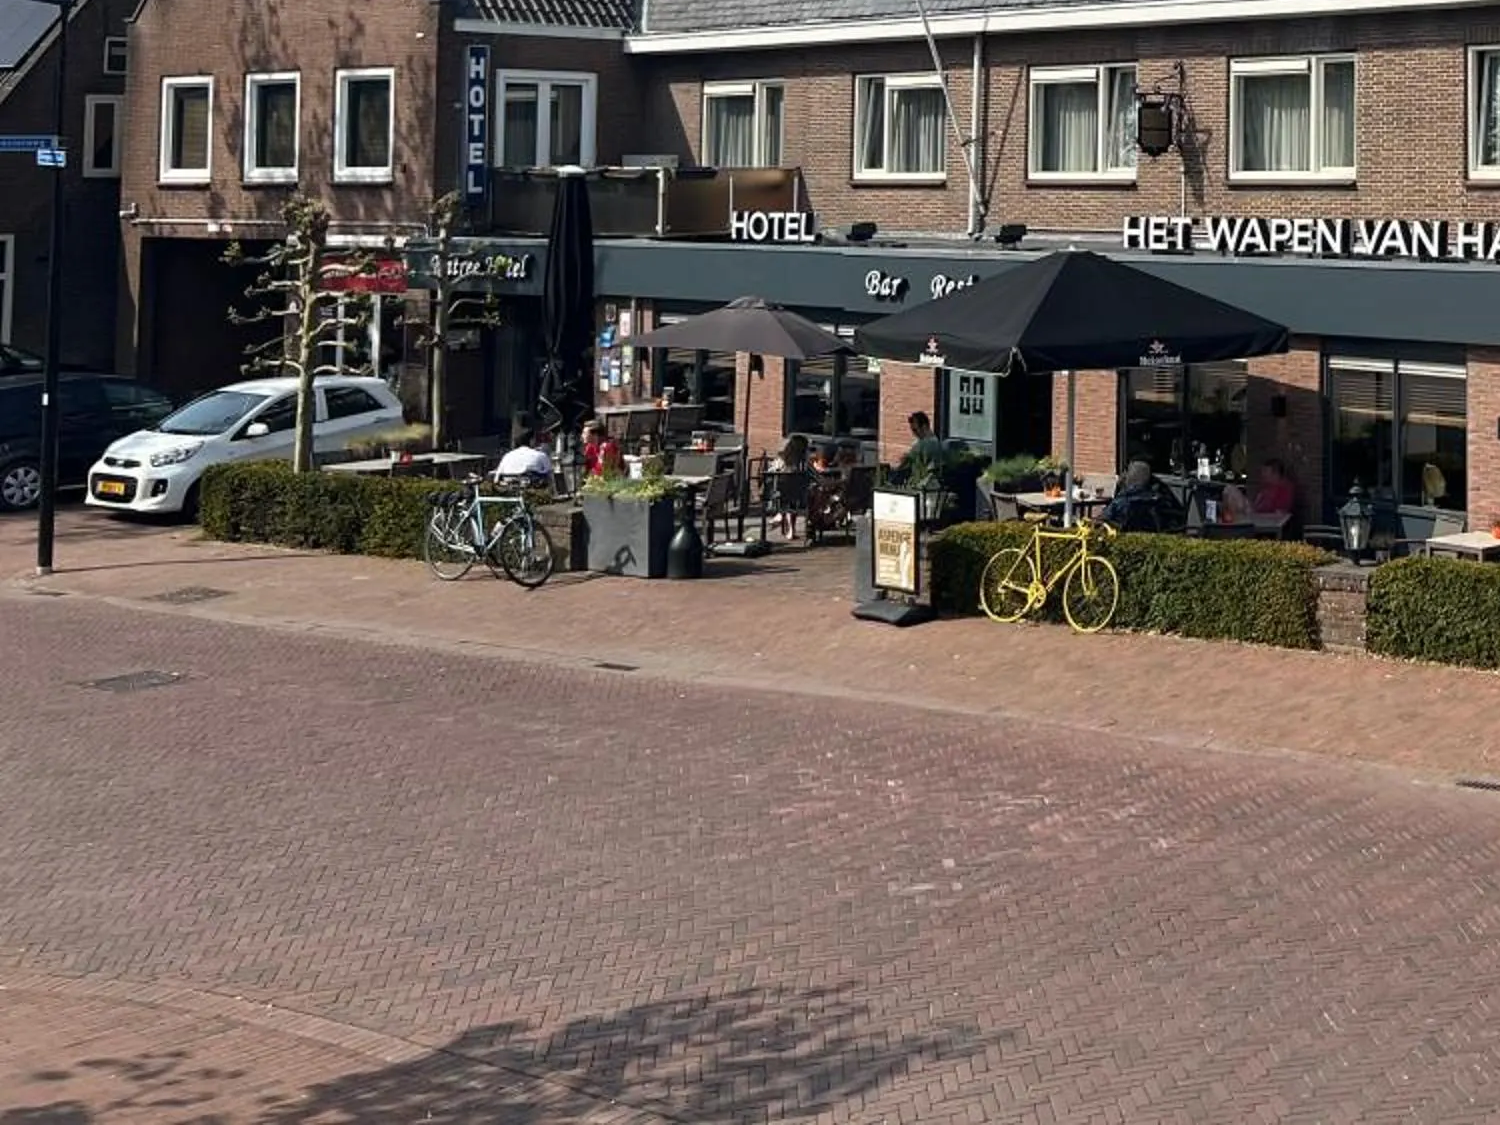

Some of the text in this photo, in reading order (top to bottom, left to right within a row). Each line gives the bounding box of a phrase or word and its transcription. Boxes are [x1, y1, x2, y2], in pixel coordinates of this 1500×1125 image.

[467, 56, 485, 194] HOTEL
[730, 210, 815, 242] HOTEL
[1123, 216, 1191, 250] HET
[1205, 216, 1344, 254] WAPEN
[1357, 219, 1440, 257] VAN
[485, 254, 529, 278] Htel
[865, 270, 902, 296] Bar
